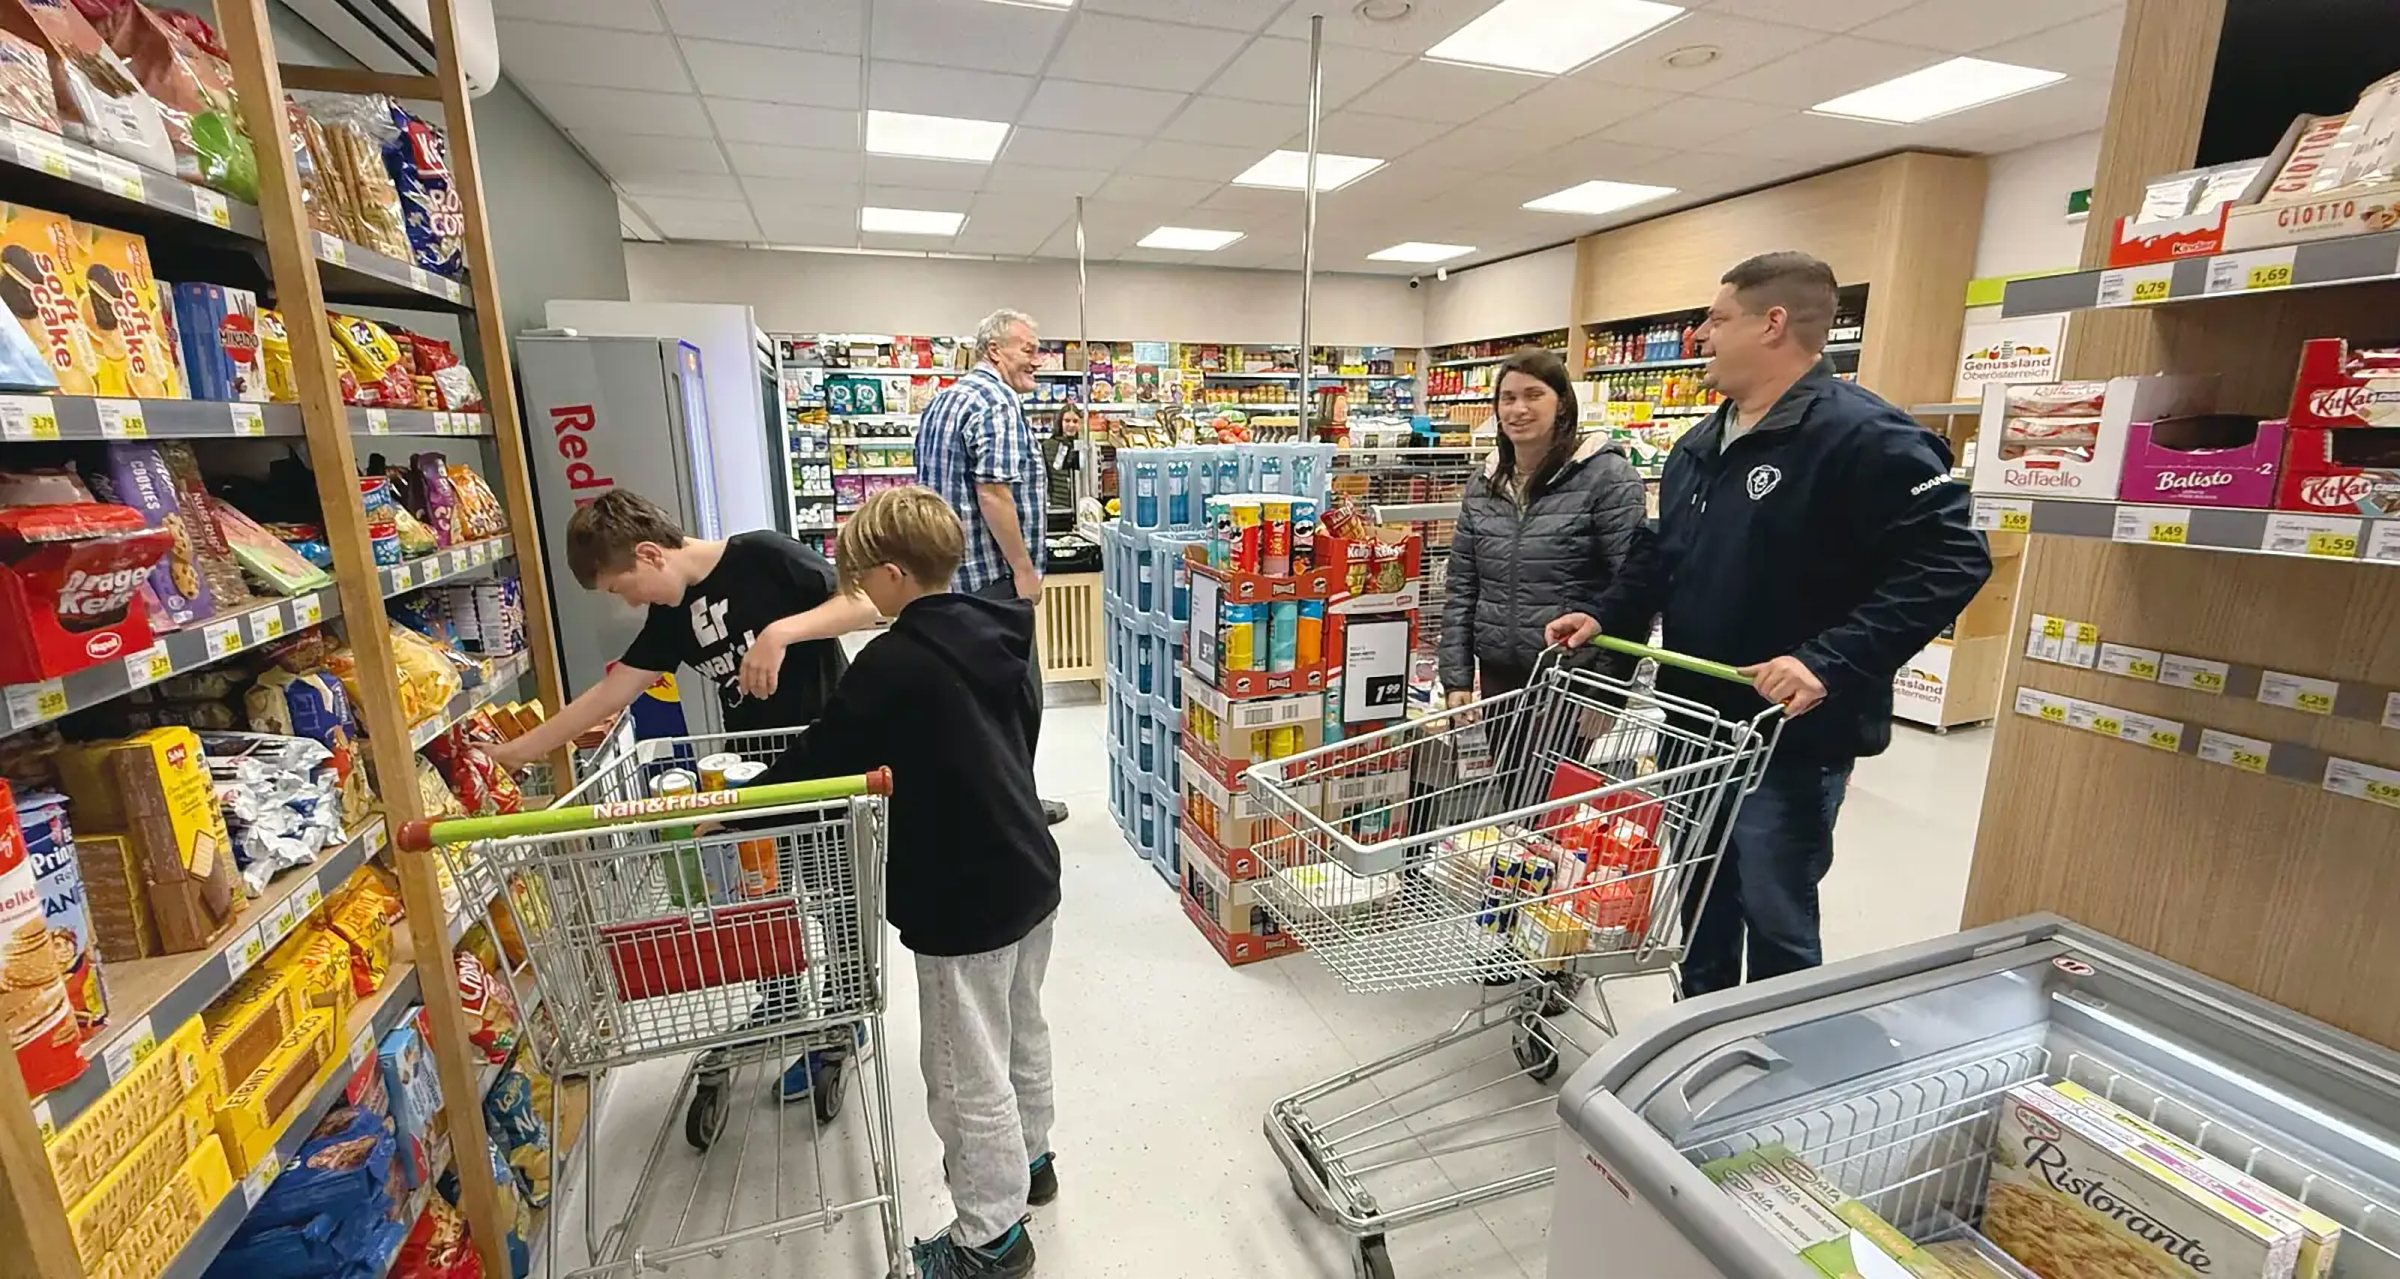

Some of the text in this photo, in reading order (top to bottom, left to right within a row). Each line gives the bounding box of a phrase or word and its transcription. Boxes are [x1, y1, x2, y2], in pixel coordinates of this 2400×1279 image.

[2279, 201, 2355, 228] GIOTTO
[36, 253, 79, 325] soft
[114, 271, 152, 336] soft
[32, 285, 72, 369] cake
[112, 300, 146, 374] cake
[219, 329, 260, 348] MIKADO
[1963, 368, 2049, 381] Oberösterreich
[1964, 357, 2051, 372] Genussland
[2317, 388, 2375, 416] KitKat
[550, 404, 615, 490] Red
[130, 460, 161, 511] COOKIES
[2004, 469, 2082, 488] Raffaello
[2155, 471, 2234, 491] Balisto
[2309, 477, 2369, 506] KitKat
[690, 595, 729, 648] Er
[2023, 1136, 2212, 1275] Ristorante
